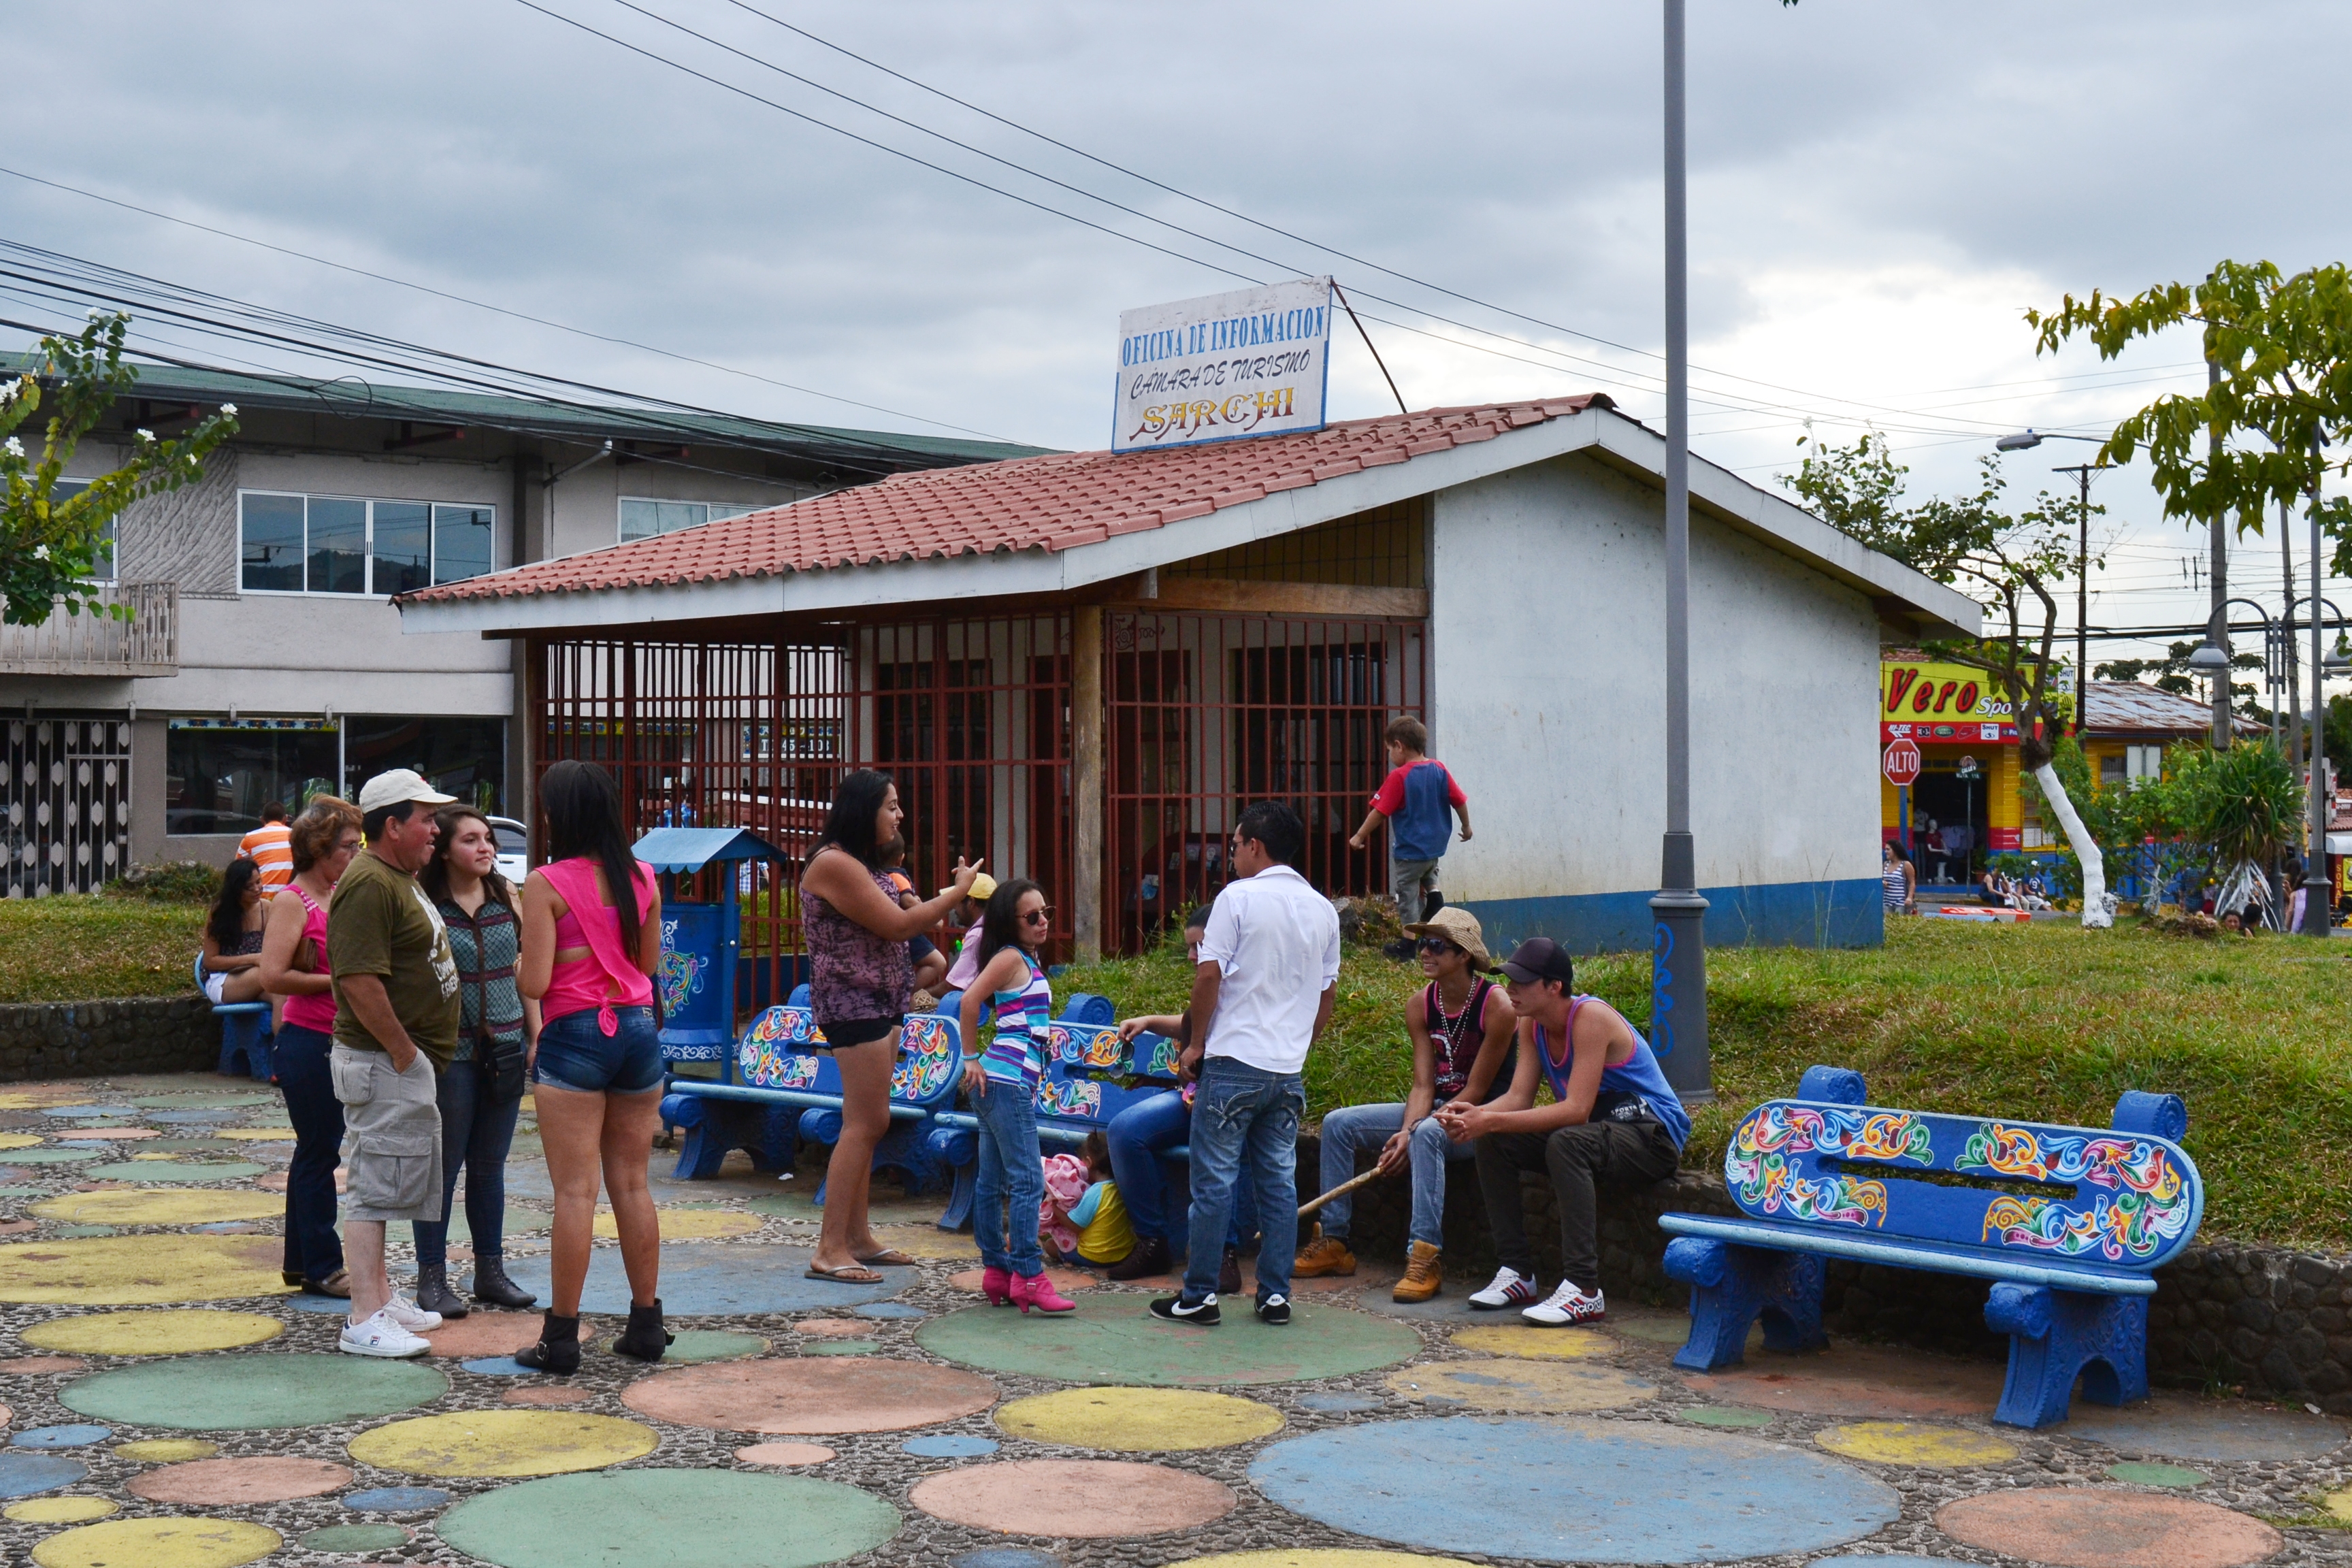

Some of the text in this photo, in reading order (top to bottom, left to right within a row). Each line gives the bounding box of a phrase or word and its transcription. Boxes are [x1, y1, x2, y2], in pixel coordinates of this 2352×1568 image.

[1123, 306, 1325, 367] OFICINA DE INFORMACION
[1203, 361, 1227, 387] DE
[1230, 348, 1311, 382] TURISMO
[1129, 387, 1295, 442] SARCHI
[1887, 668, 1978, 713] Vero
[1976, 696, 2029, 718] Spot
[1886, 751, 1918, 773] ALTO
